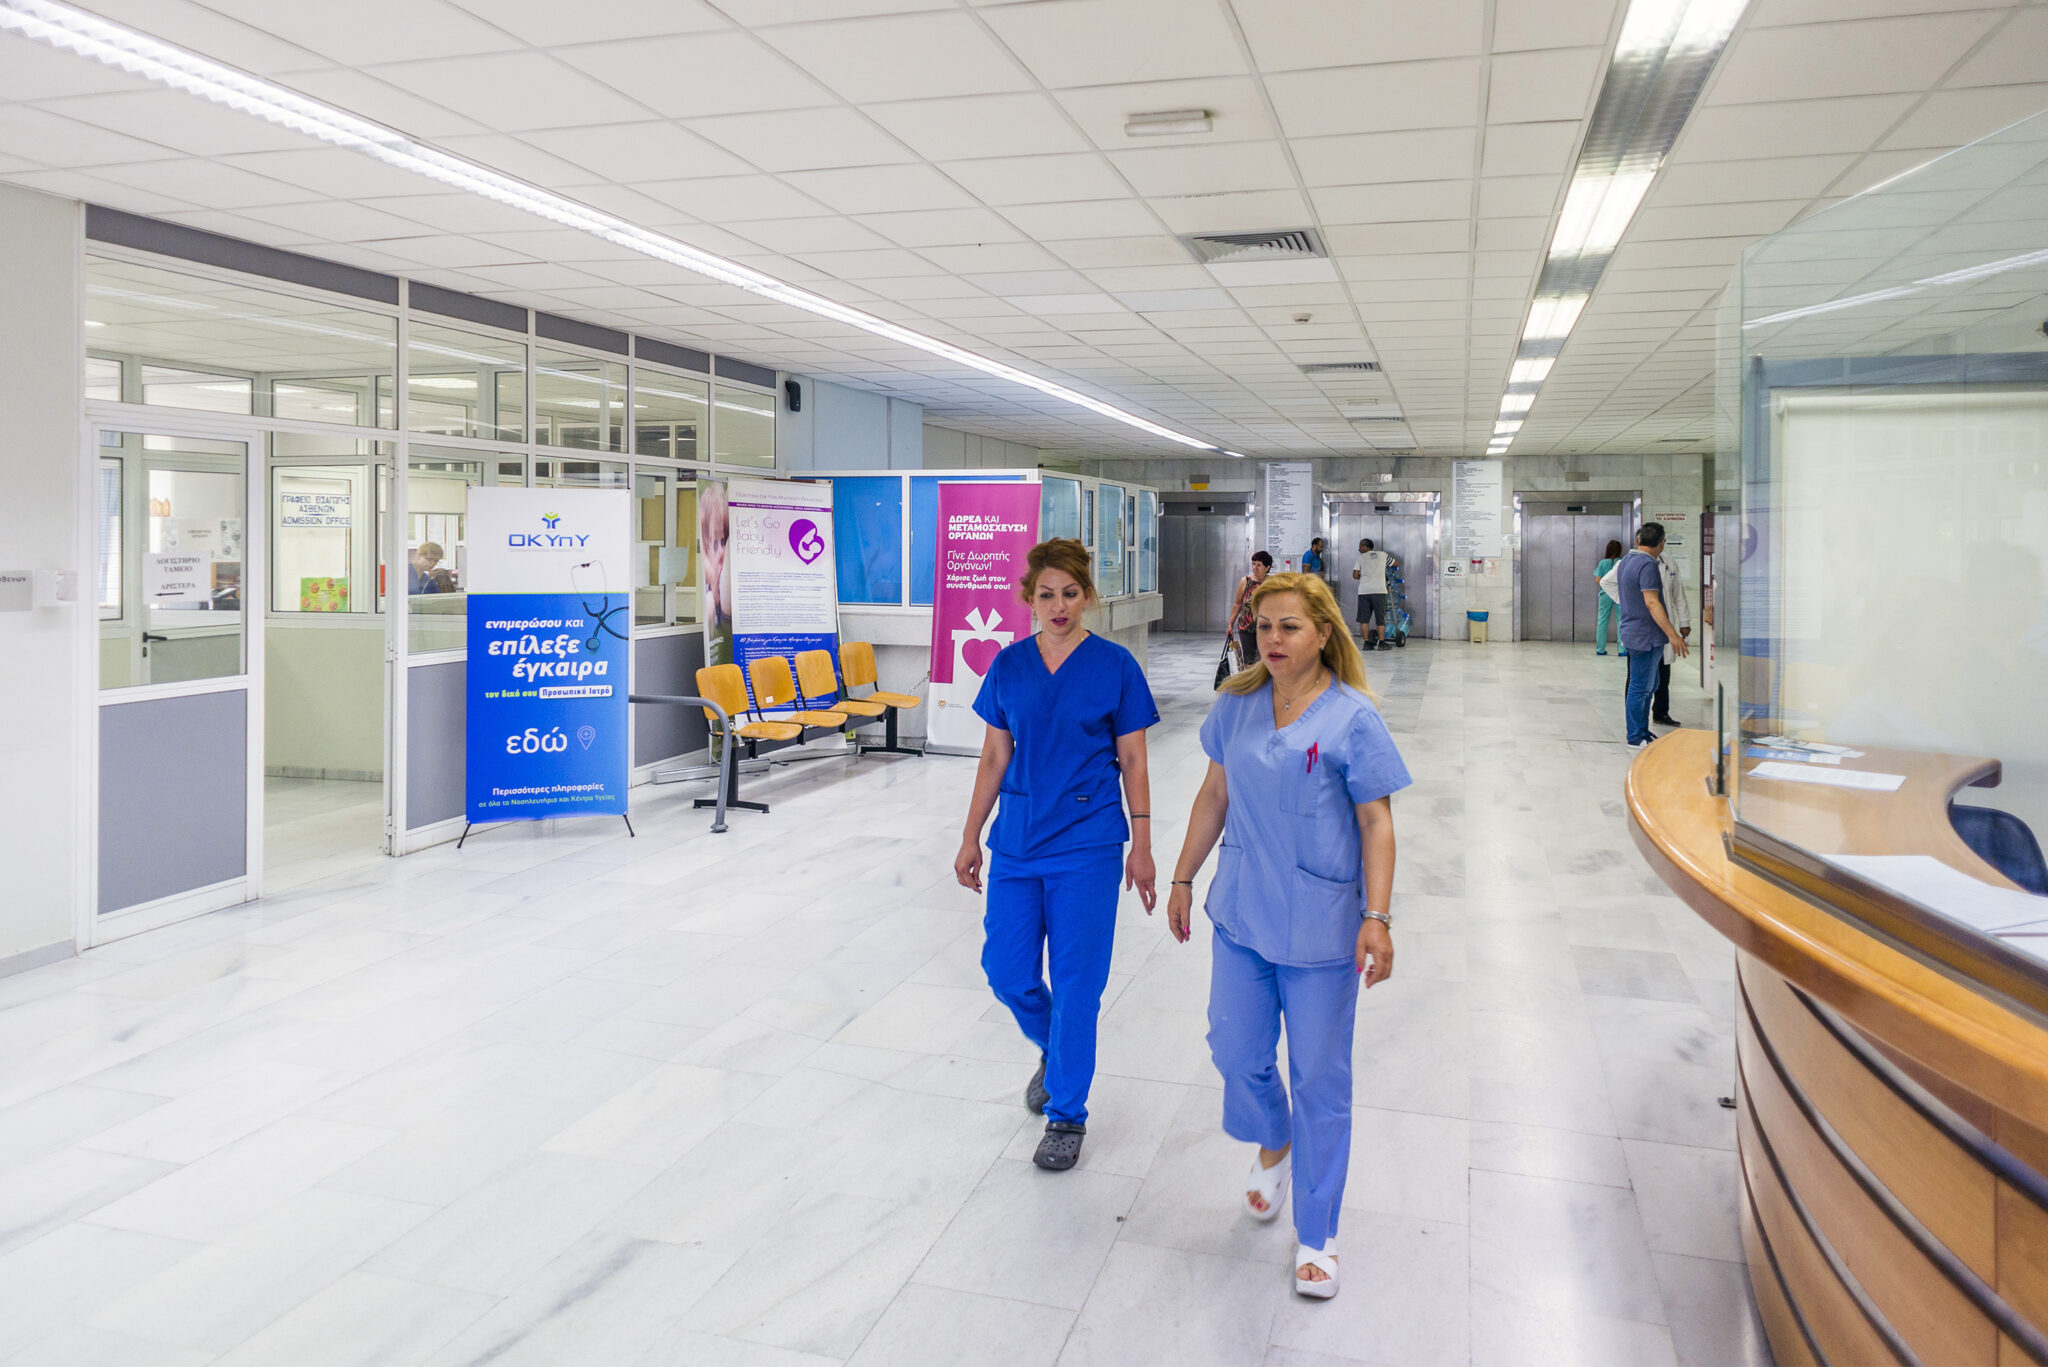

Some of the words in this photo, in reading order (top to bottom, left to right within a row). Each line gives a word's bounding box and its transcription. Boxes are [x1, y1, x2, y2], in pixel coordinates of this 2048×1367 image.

[282, 495, 312, 504] ΓΡΑΦΕΙΟ
[299, 504, 336, 513] ΑΣΘΕΝΩΝ
[282, 516, 323, 525] ADMISSION
[325, 516, 350, 525] OFFICE
[736, 515, 759, 528] Let's
[762, 516, 781, 529] Go
[948, 515, 982, 523] ΔΩΡΕΑ
[984, 515, 1000, 523] ΚΑΙ
[948, 523, 1028, 532] ΜΕΤΑΜΟΣΧΕΥΣΗ
[736, 528, 765, 544] Baby
[948, 532, 994, 540] ΟΡΓΑΝΩΝ
[736, 542, 782, 558] Friendly
[947, 549, 966, 560] Γίνε
[967, 549, 1010, 562] Δωρητής
[156, 557, 201, 565] ΛΟΓΙΣΤΗΡΙΟ
[946, 560, 992, 572] Οργάνων!
[946, 573, 971, 582] Χάρισε
[972, 573, 987, 582] ζωή
[160, 582, 196, 590] ΑΡΙΣΤΕΡΑ
[946, 582, 992, 590] συνάνθρωπό
[485, 617, 561, 631] ενημερώσου
[565, 619, 584, 628] και
[488, 634, 581, 659] επίλεξε
[512, 658, 609, 682] έγκαιρα
[501, 689, 520, 698] δικό
[542, 688, 587, 697] Προσωπικό
[589, 687, 610, 696] Ιατρό
[506, 726, 568, 754] εδώ
[492, 785, 550, 796] Περισσότερες
[551, 782, 605, 793] πληροφορίες
[488, 799, 501, 807] όλα
[511, 796, 558, 805] Νοσηλευτήρια
[570, 794, 594, 802] Κέντρα
[594, 793, 616, 802] Υγείας
